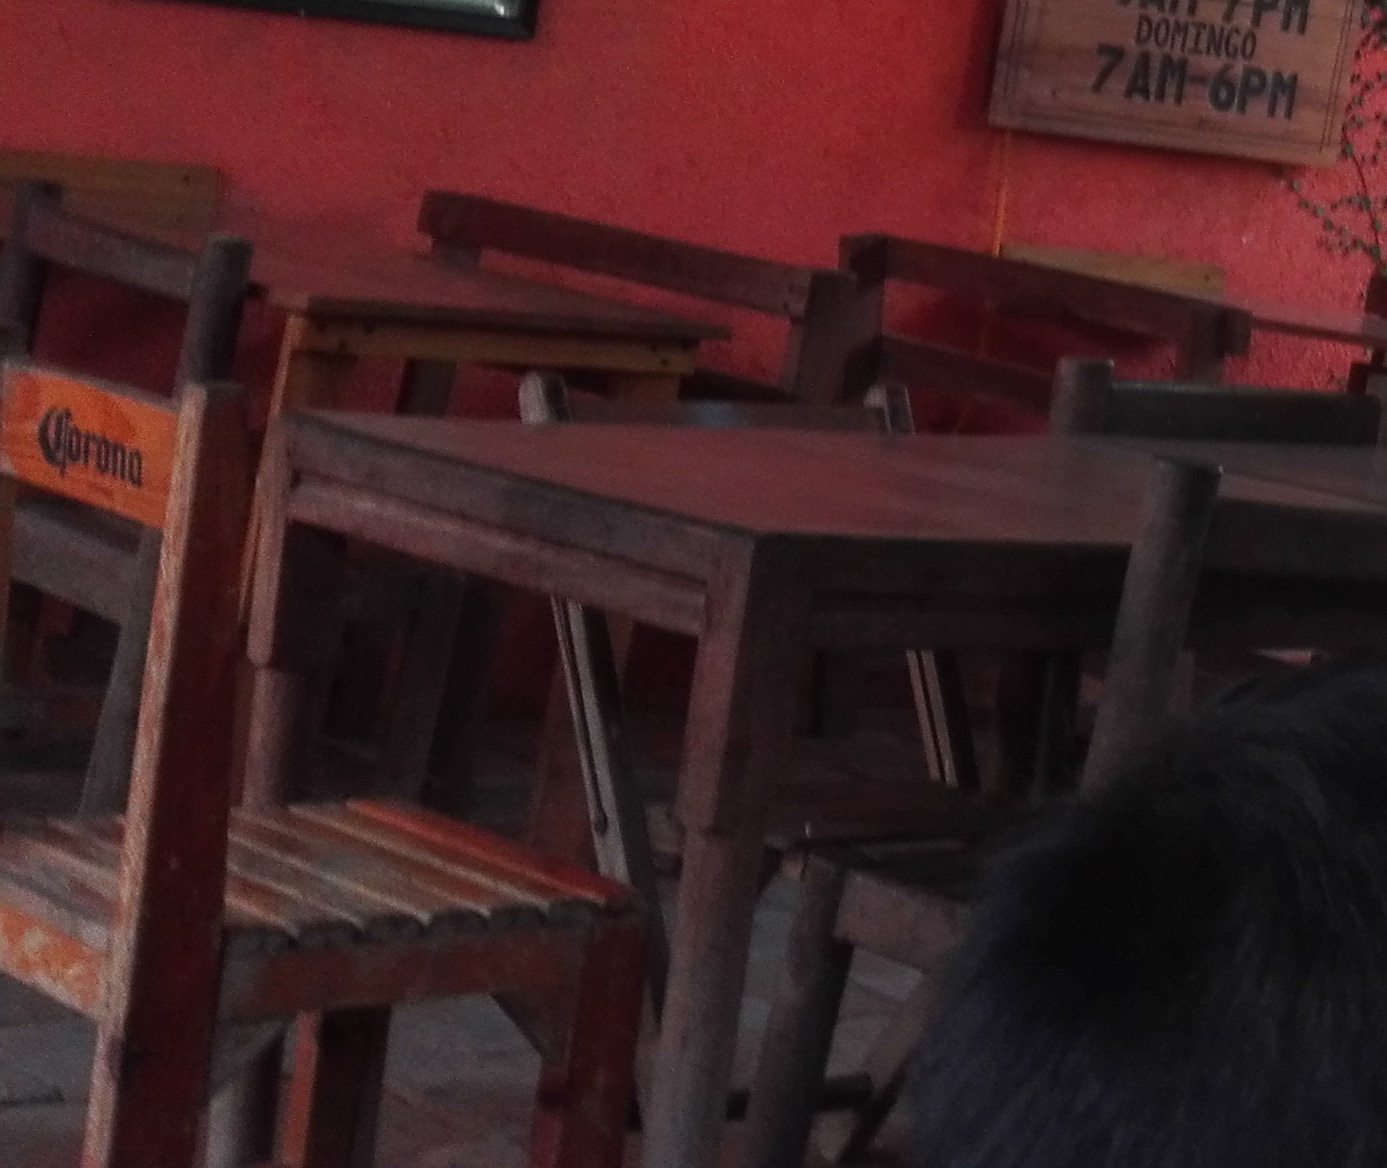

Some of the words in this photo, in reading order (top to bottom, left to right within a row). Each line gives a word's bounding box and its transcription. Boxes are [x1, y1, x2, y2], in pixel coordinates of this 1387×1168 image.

[1134, 14, 1258, 61] DOMINGO
[1093, 44, 1300, 121] 7AM-6PM
[37, 405, 143, 489] Corona
